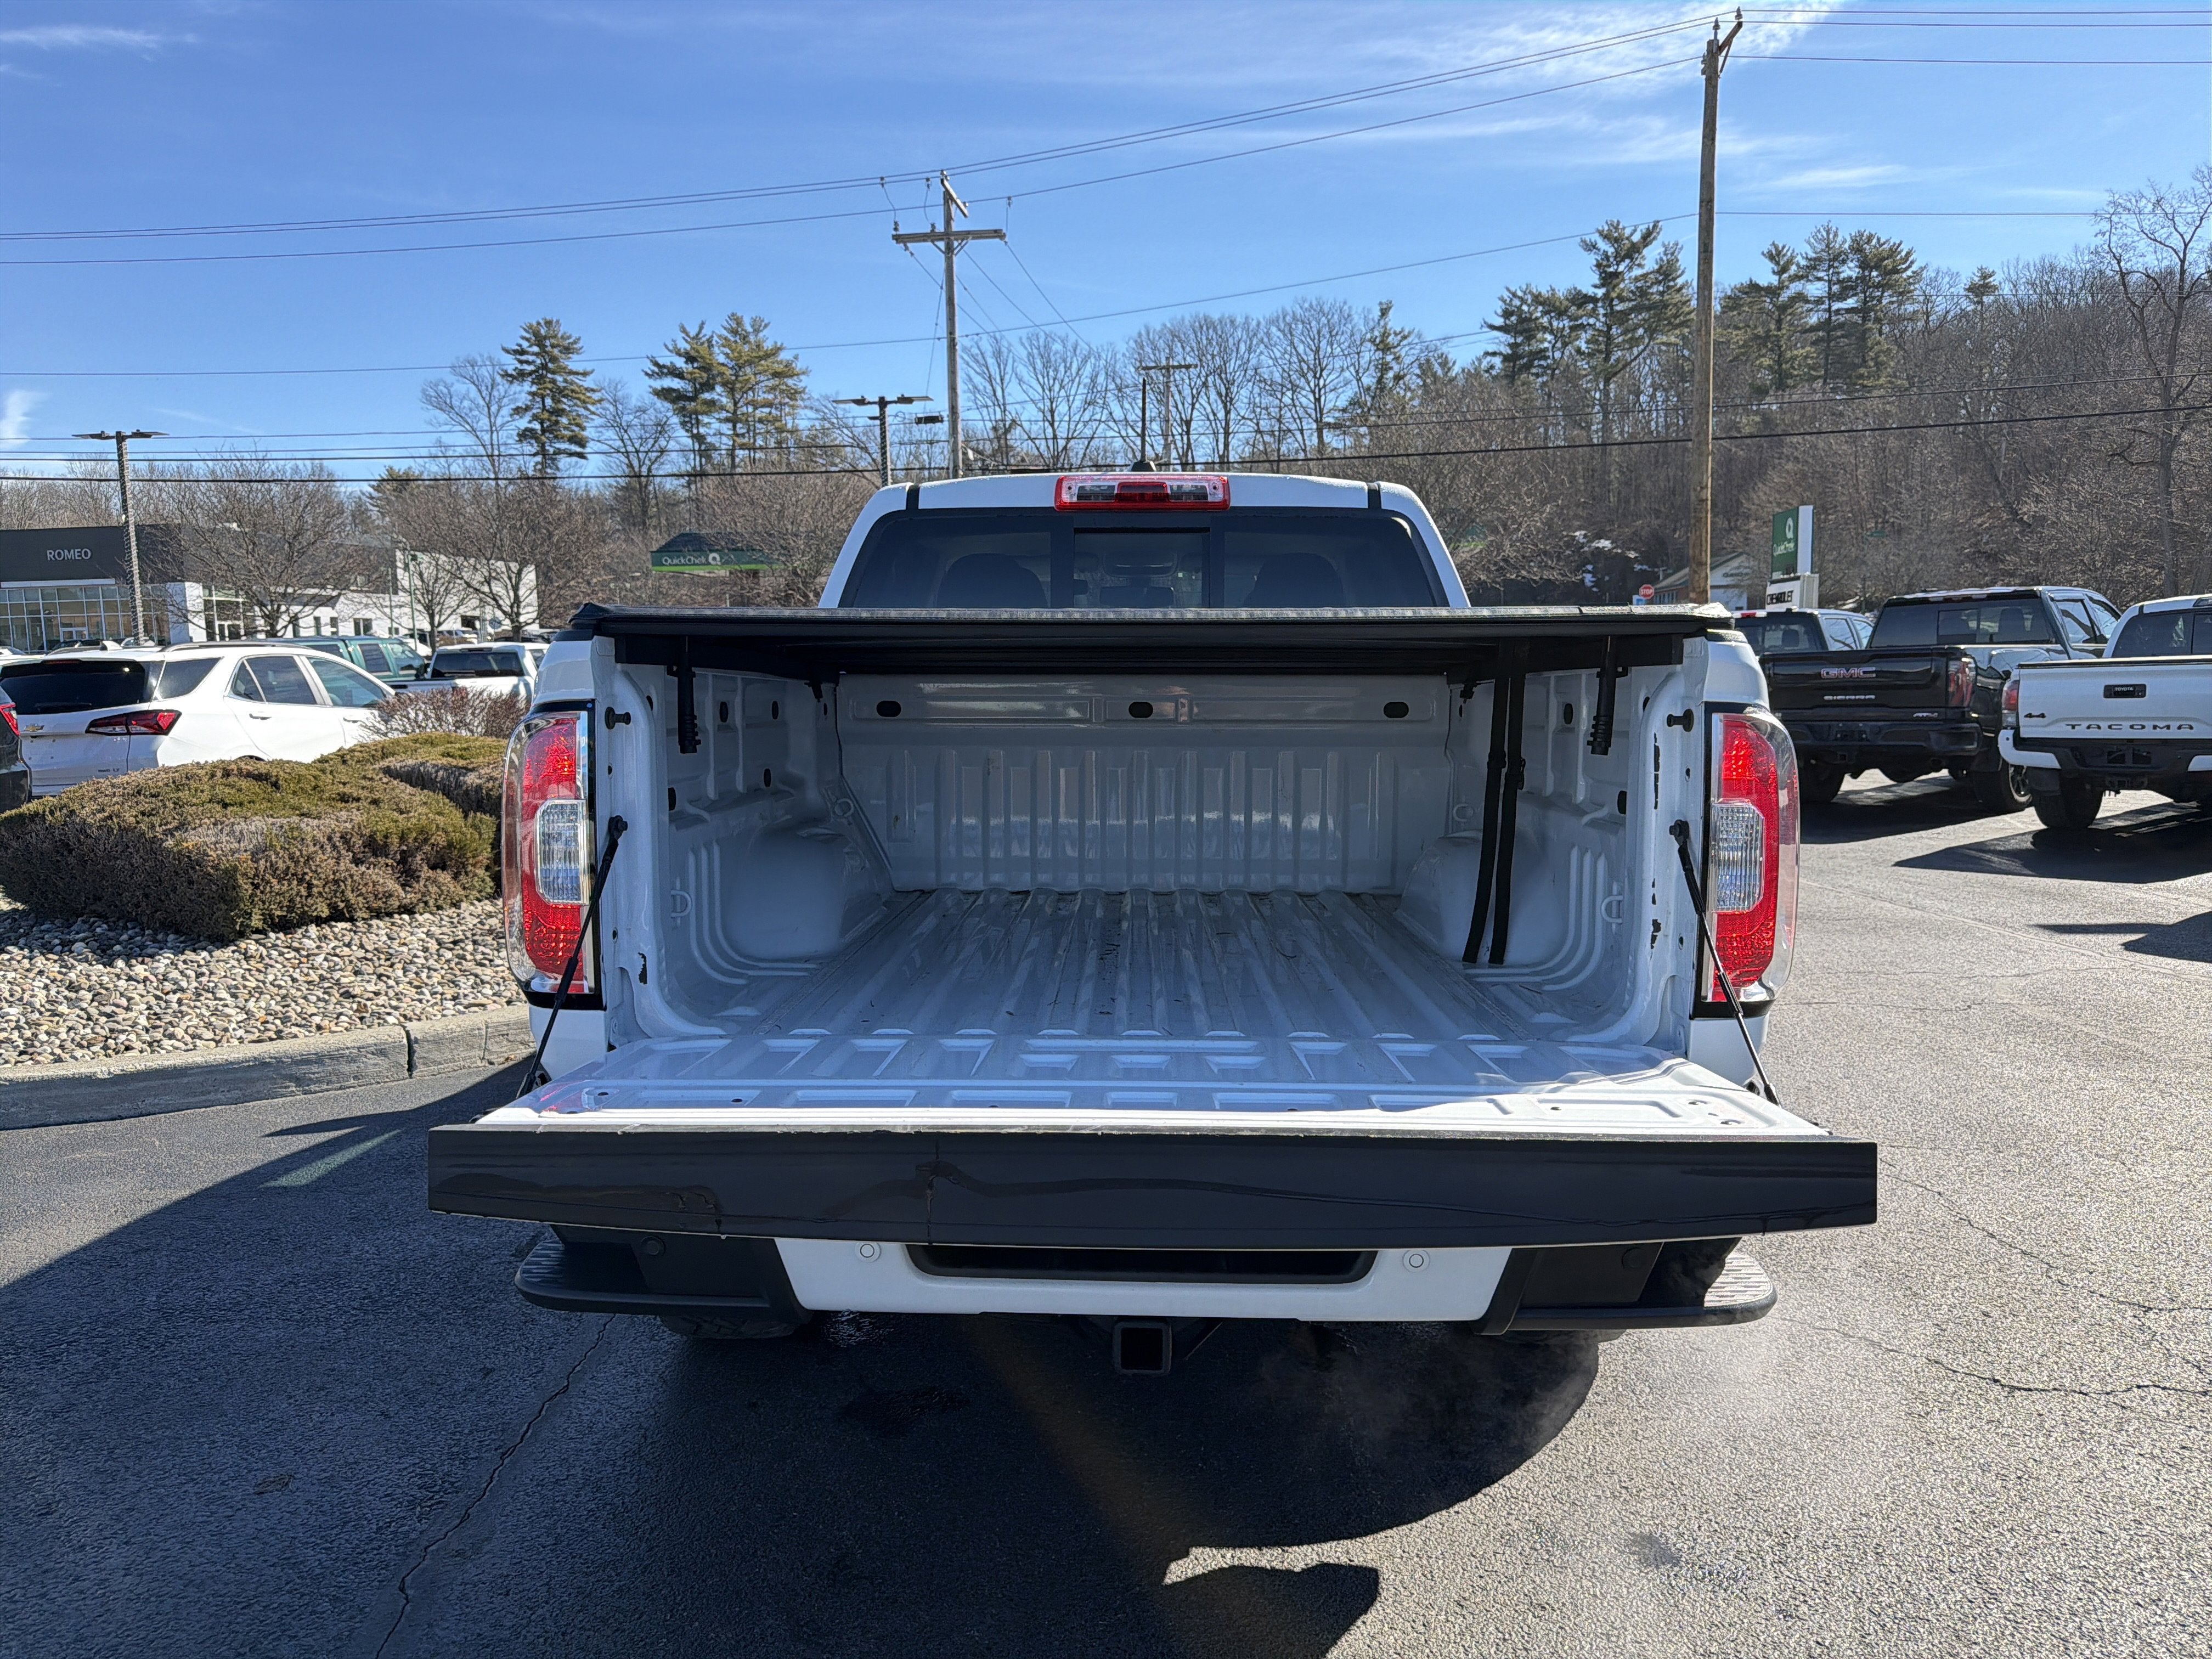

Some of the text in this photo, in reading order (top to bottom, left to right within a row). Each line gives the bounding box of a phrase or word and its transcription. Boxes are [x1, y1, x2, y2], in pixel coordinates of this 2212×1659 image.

[47, 549, 92, 561] ROMEO
[662, 556, 707, 566] QuickChek
[1821, 667, 1876, 679] GMC
